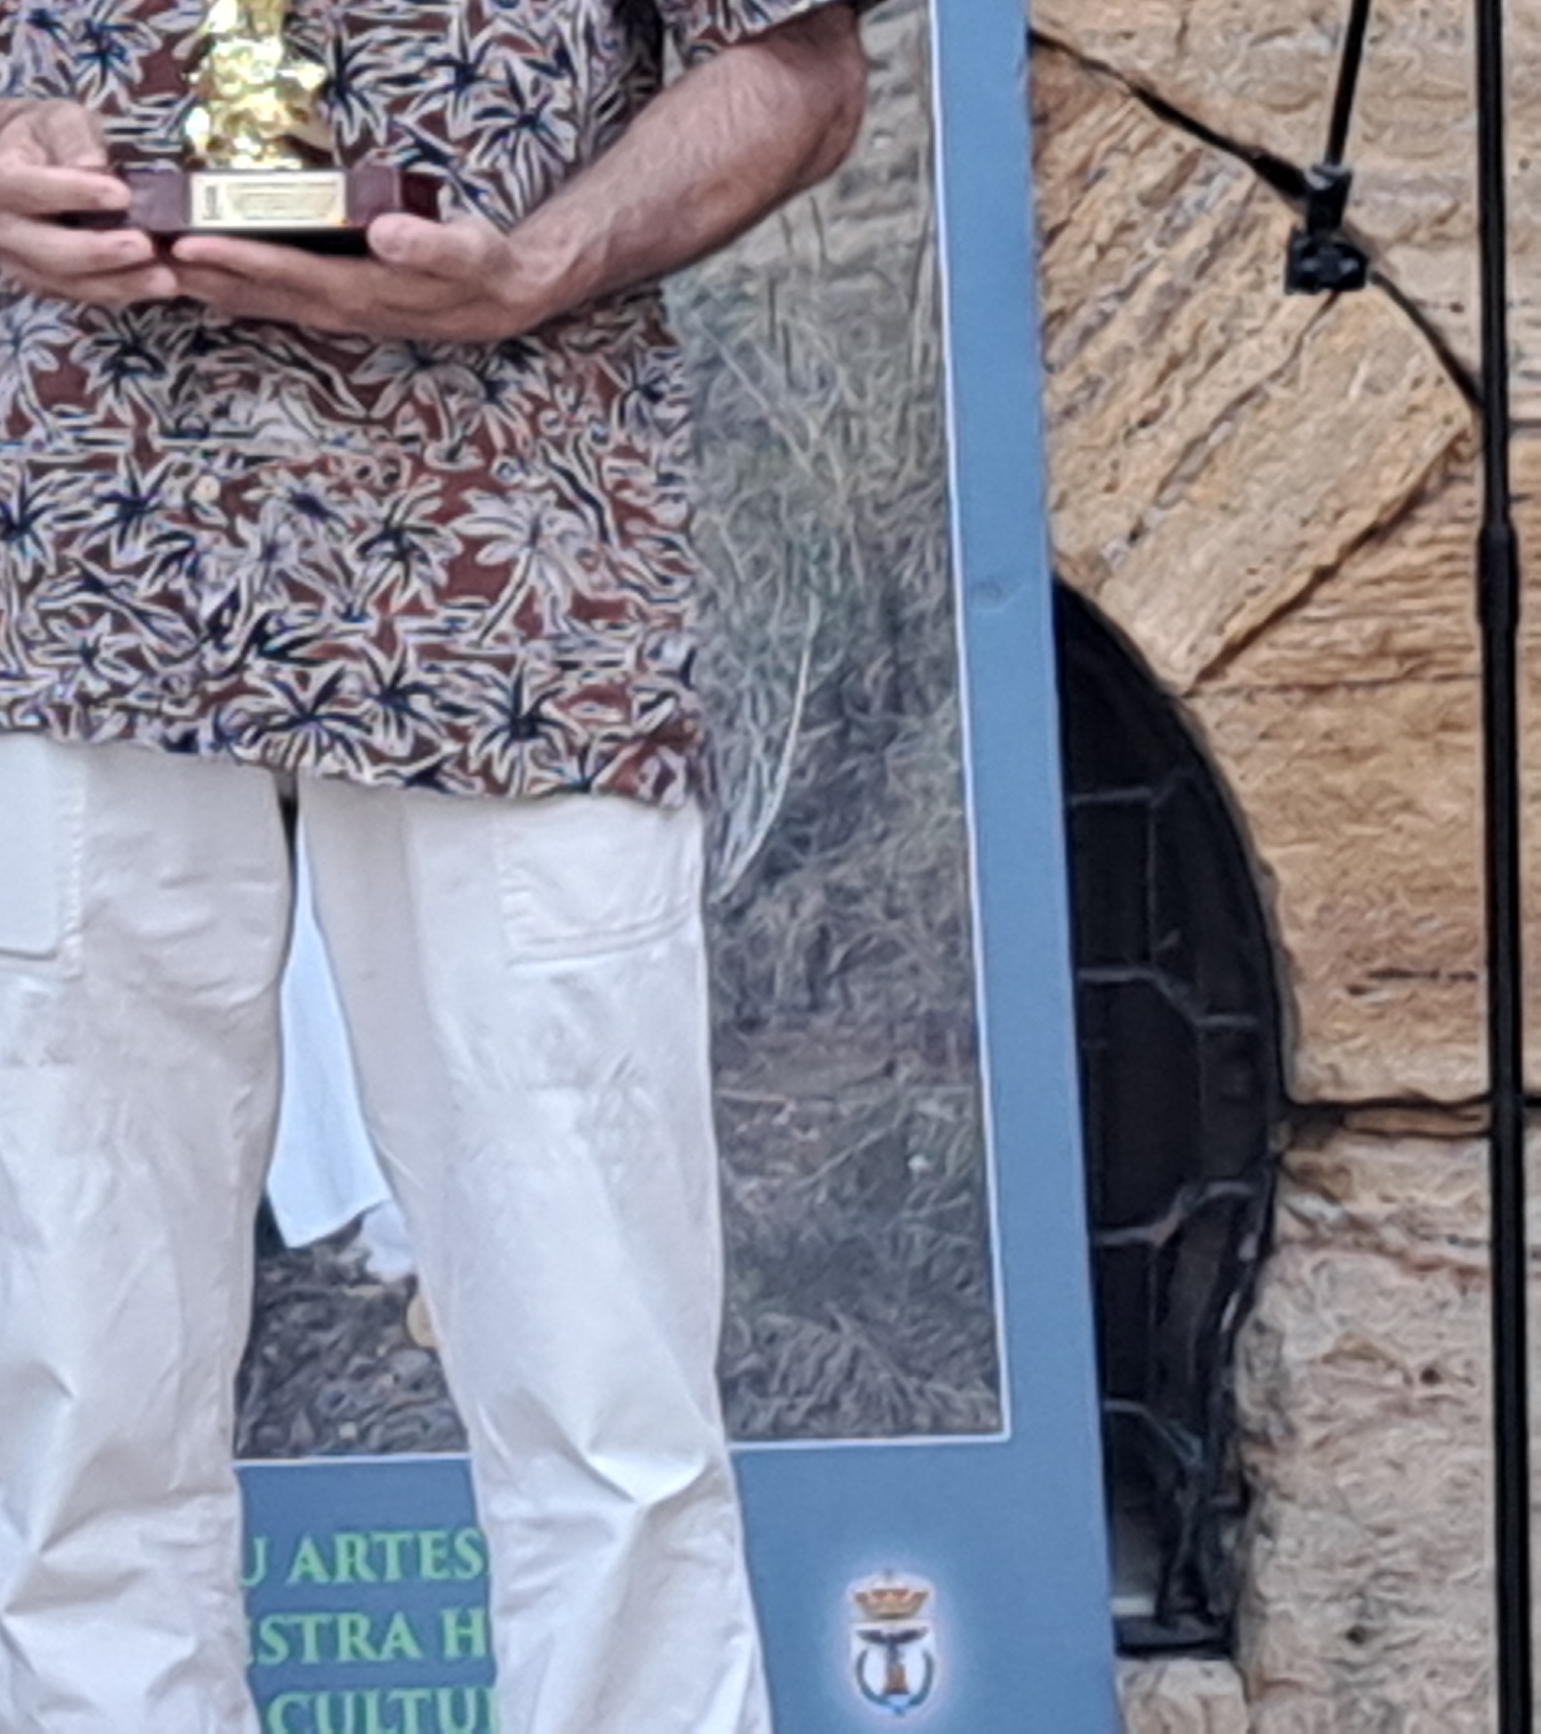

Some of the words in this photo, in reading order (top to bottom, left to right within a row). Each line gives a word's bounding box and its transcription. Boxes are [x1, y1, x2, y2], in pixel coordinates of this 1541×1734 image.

[285, 1527, 487, 1586] ARTES
[249, 1610, 423, 1666] STRA
[268, 1686, 499, 1734] CULTU
